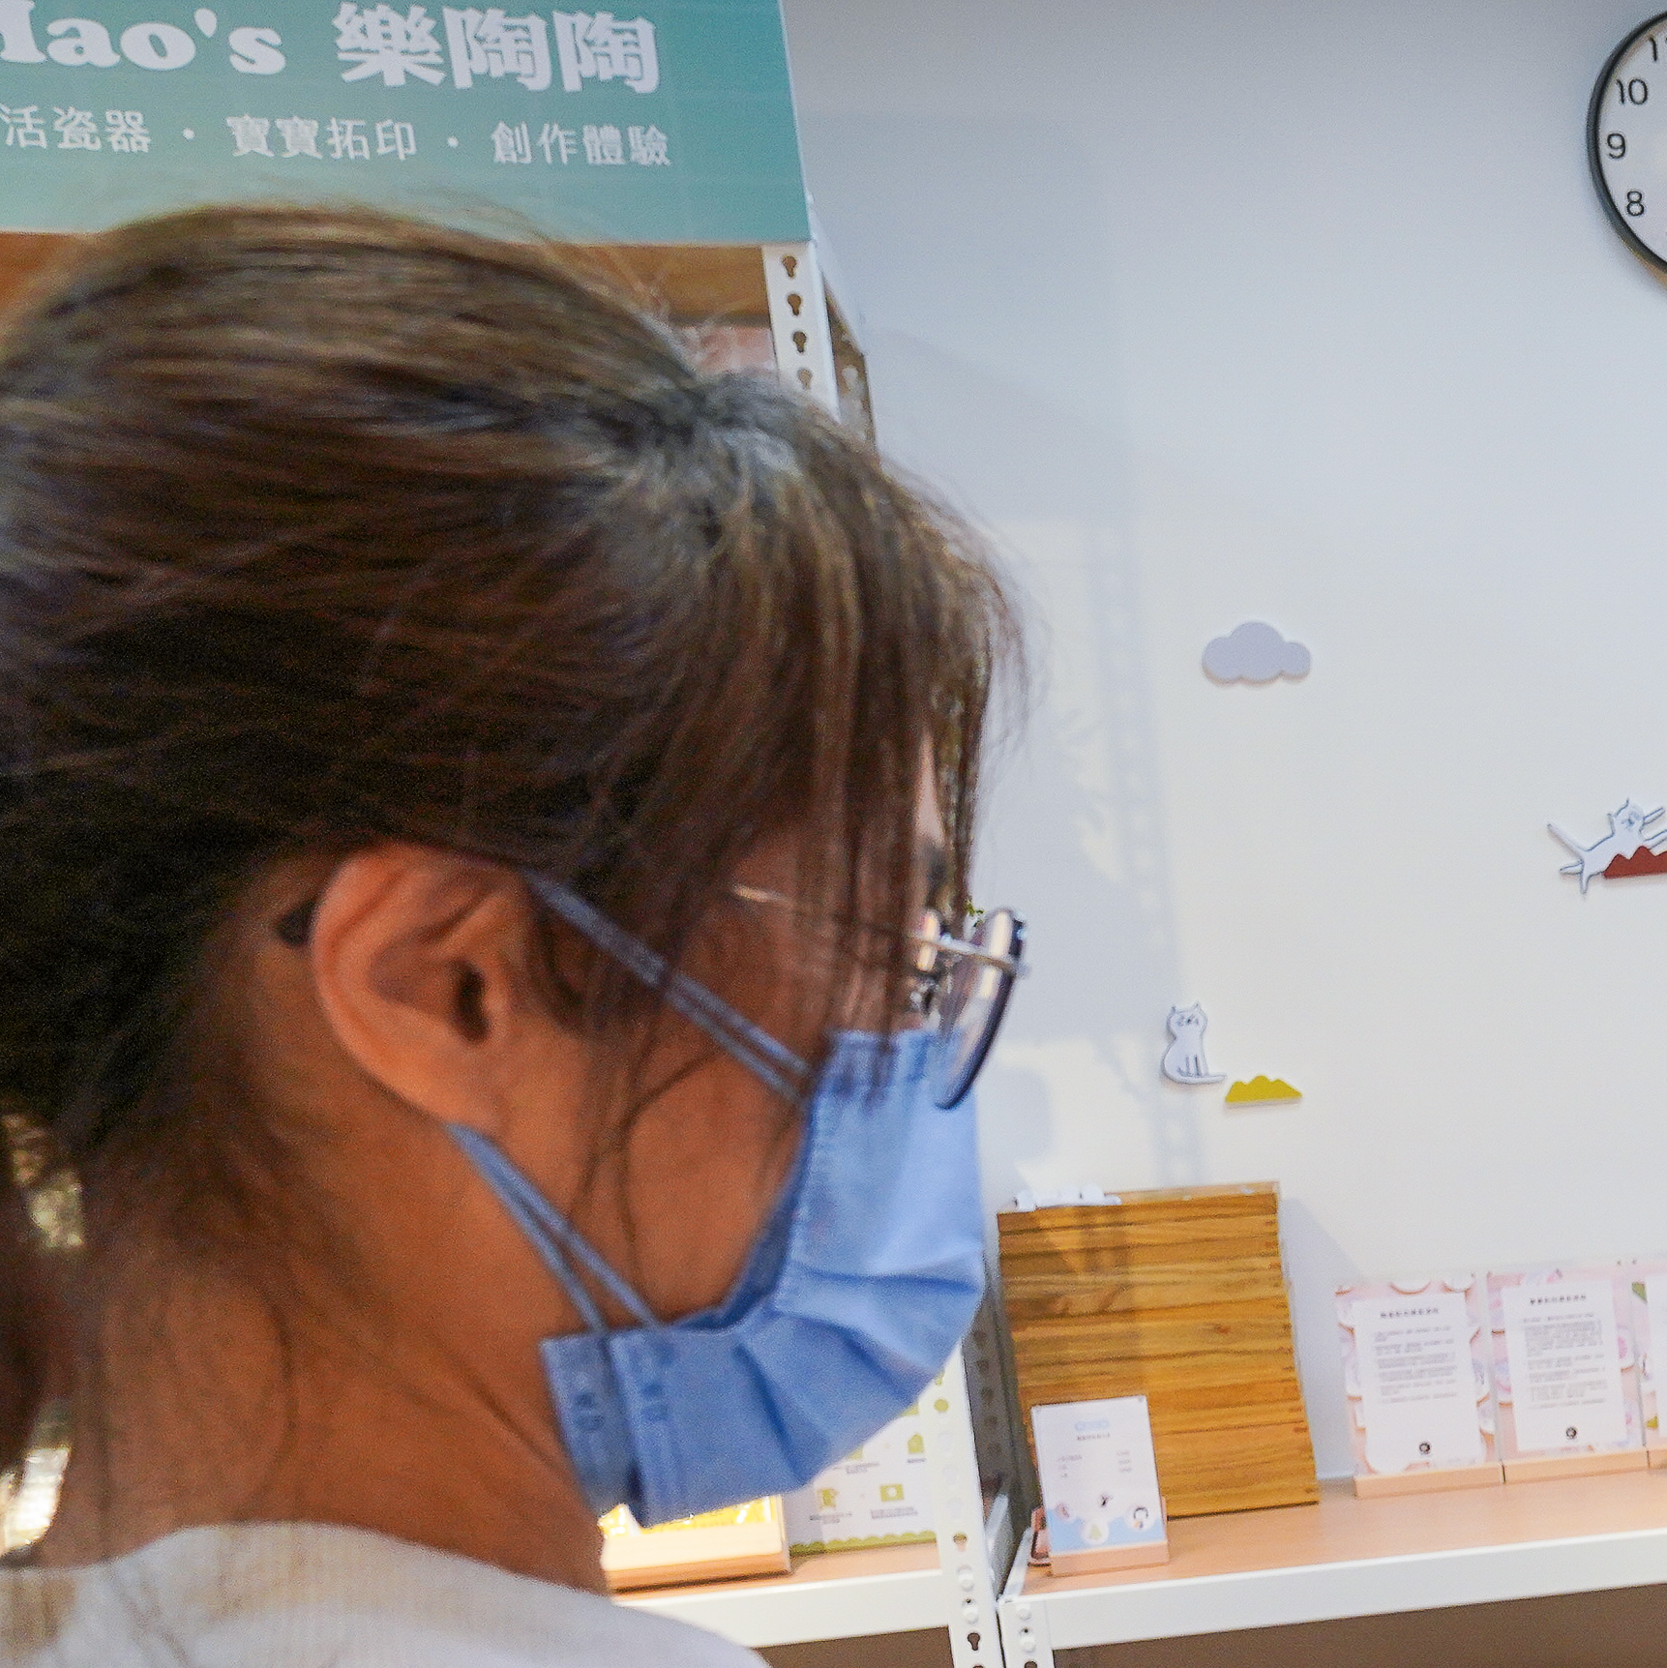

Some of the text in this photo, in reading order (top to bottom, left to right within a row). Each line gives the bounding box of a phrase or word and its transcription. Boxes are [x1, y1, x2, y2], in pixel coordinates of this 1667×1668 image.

[331, 2, 660, 93] 樂陶陶
[1616, 77, 1648, 106] 10
[0, 103, 672, 167] 活瓷器 寶寶拓印 創作體驗
[1606, 132, 1627, 160] 9
[1625, 190, 1645, 217] 8
